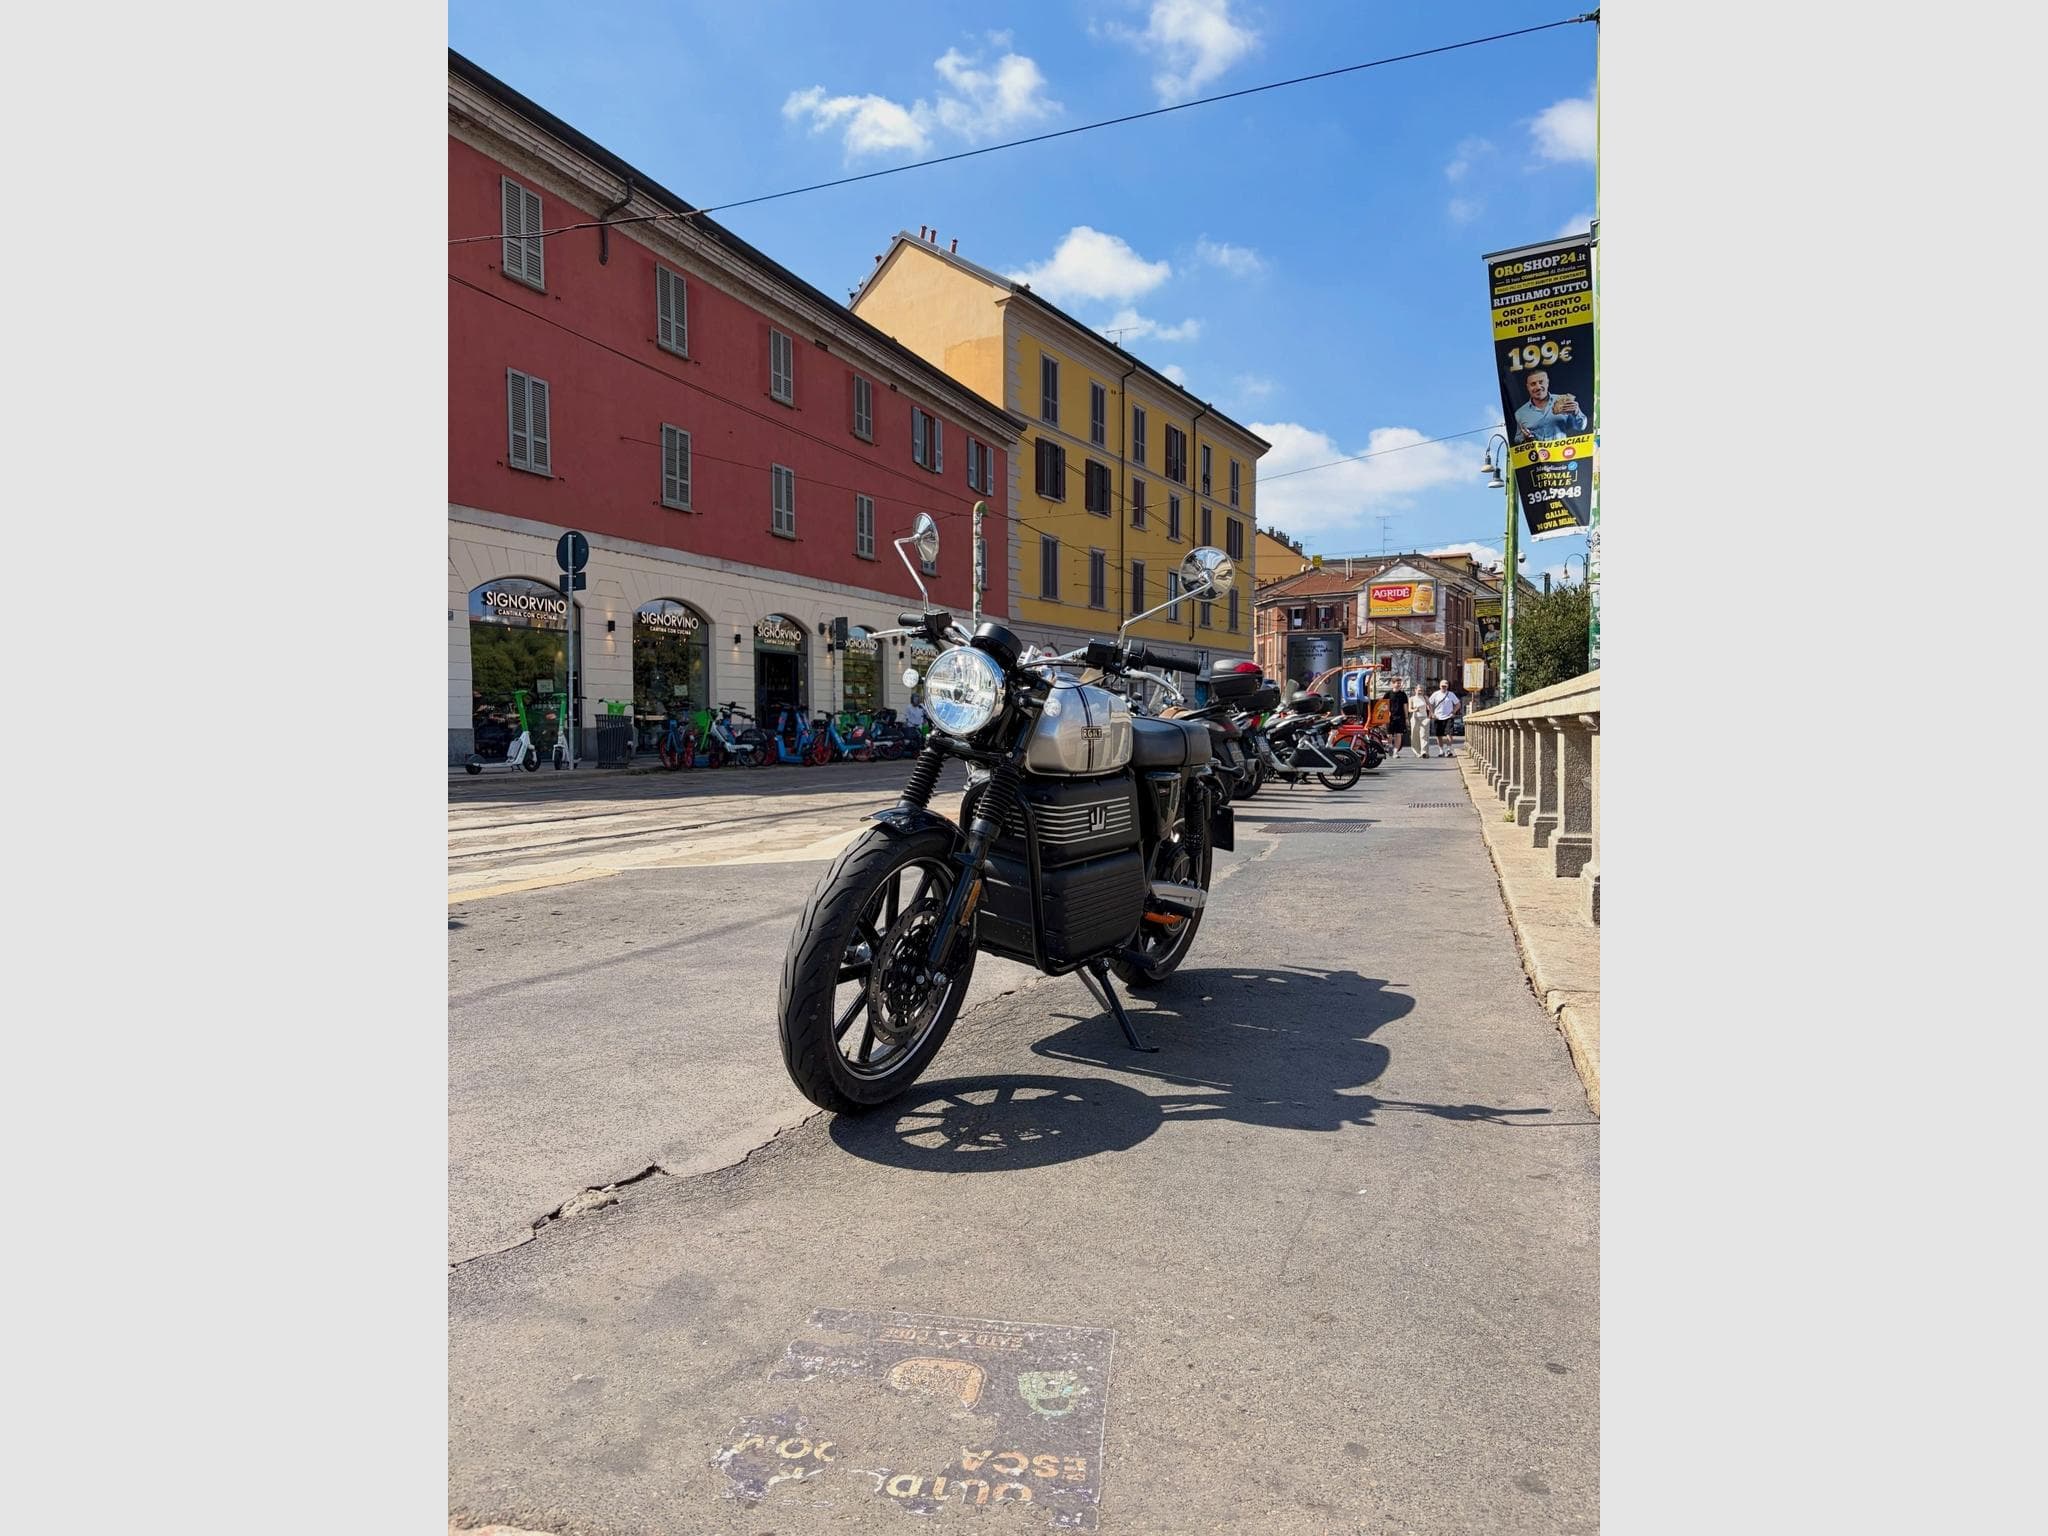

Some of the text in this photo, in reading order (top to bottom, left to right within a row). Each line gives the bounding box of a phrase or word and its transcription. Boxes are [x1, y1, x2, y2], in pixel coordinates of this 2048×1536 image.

[1494, 252, 1586, 278] OROSHOP24.it
[1493, 280, 1589, 307] RITIRIAMO TUTTO
[1495, 313, 1536, 328] MONETE
[1544, 304, 1591, 318] OROLOGI
[1502, 307, 1524, 318] ORO
[1533, 296, 1582, 312] ARGENTO
[1518, 317, 1568, 333] DIAMANTI
[1508, 341, 1573, 372] 199€
[1554, 436, 1590, 448] SOCIAL!
[1537, 520, 1558, 530] NOVA
[486, 591, 567, 614] SIGNORVINO
[498, 609, 522, 617] CANTINA
[641, 611, 699, 629] SIGNORVINO
[757, 626, 802, 641] SIGNORVINO
